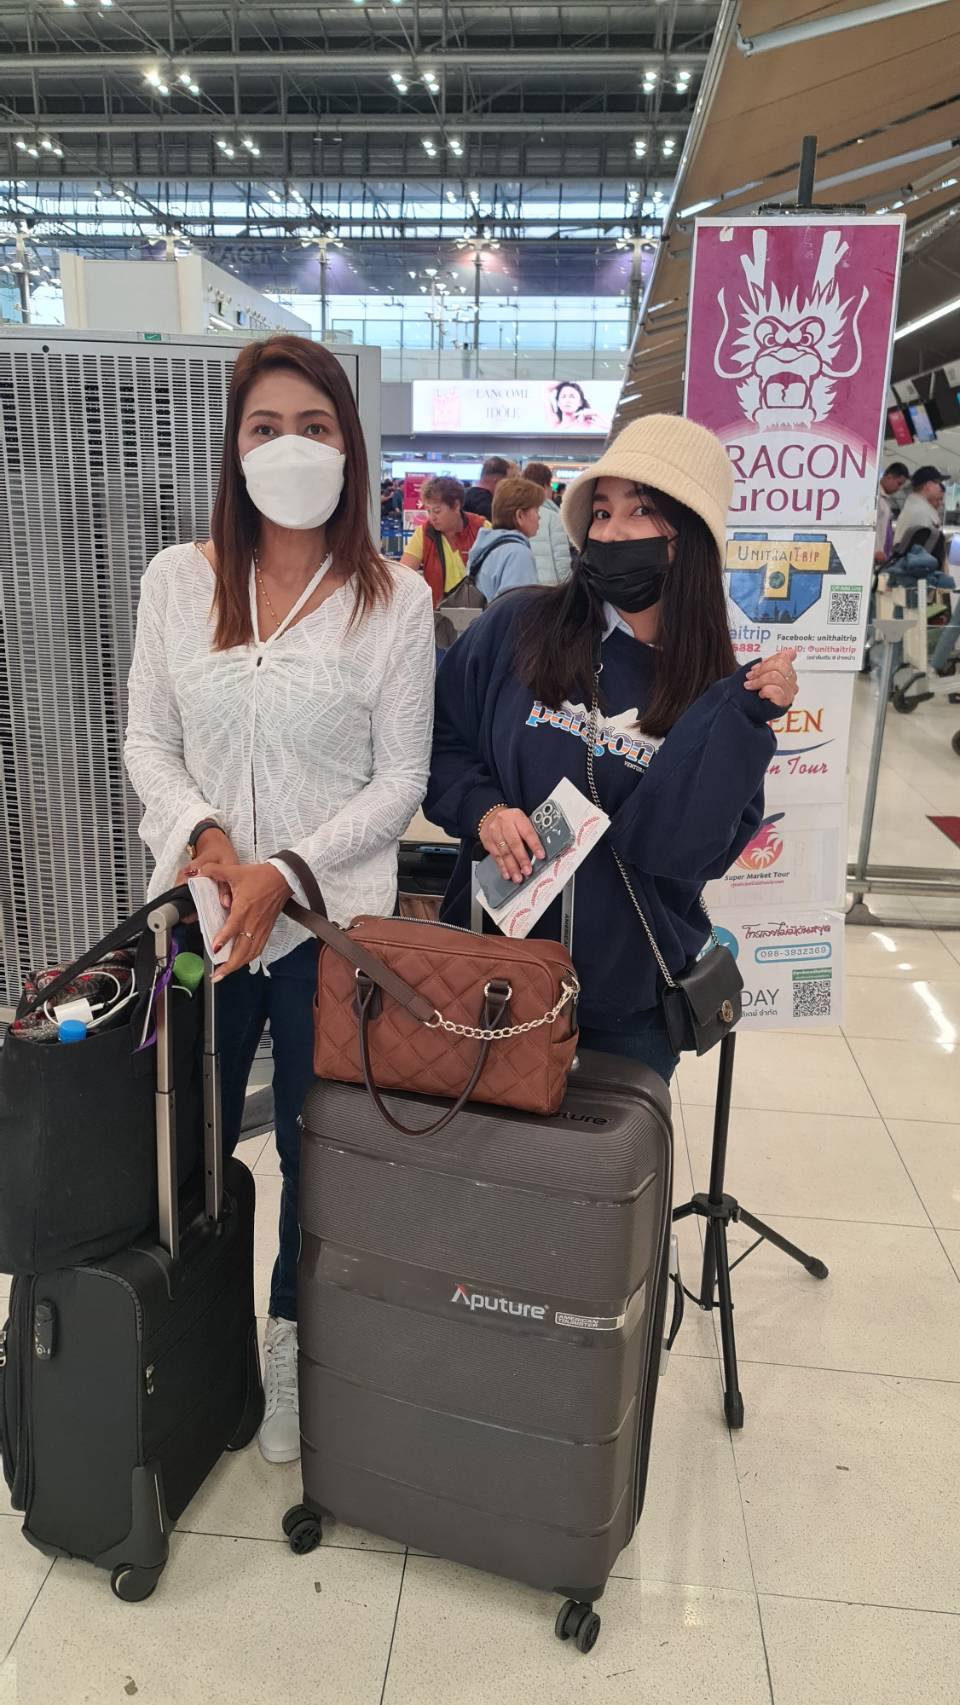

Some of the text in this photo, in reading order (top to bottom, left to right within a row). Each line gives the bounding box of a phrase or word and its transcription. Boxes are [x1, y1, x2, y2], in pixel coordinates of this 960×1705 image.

[725, 444, 868, 479] RAGON
[729, 625, 771, 644] aitrip
[776, 633, 857, 643] Facebook: unithaitrip
[768, 707, 824, 732] EEN
[787, 757, 828, 775] Tour
[724, 871, 790, 882] Super Market Tour
[740, 989, 780, 1007] DAY
[451, 1283, 545, 1320] Aputure
